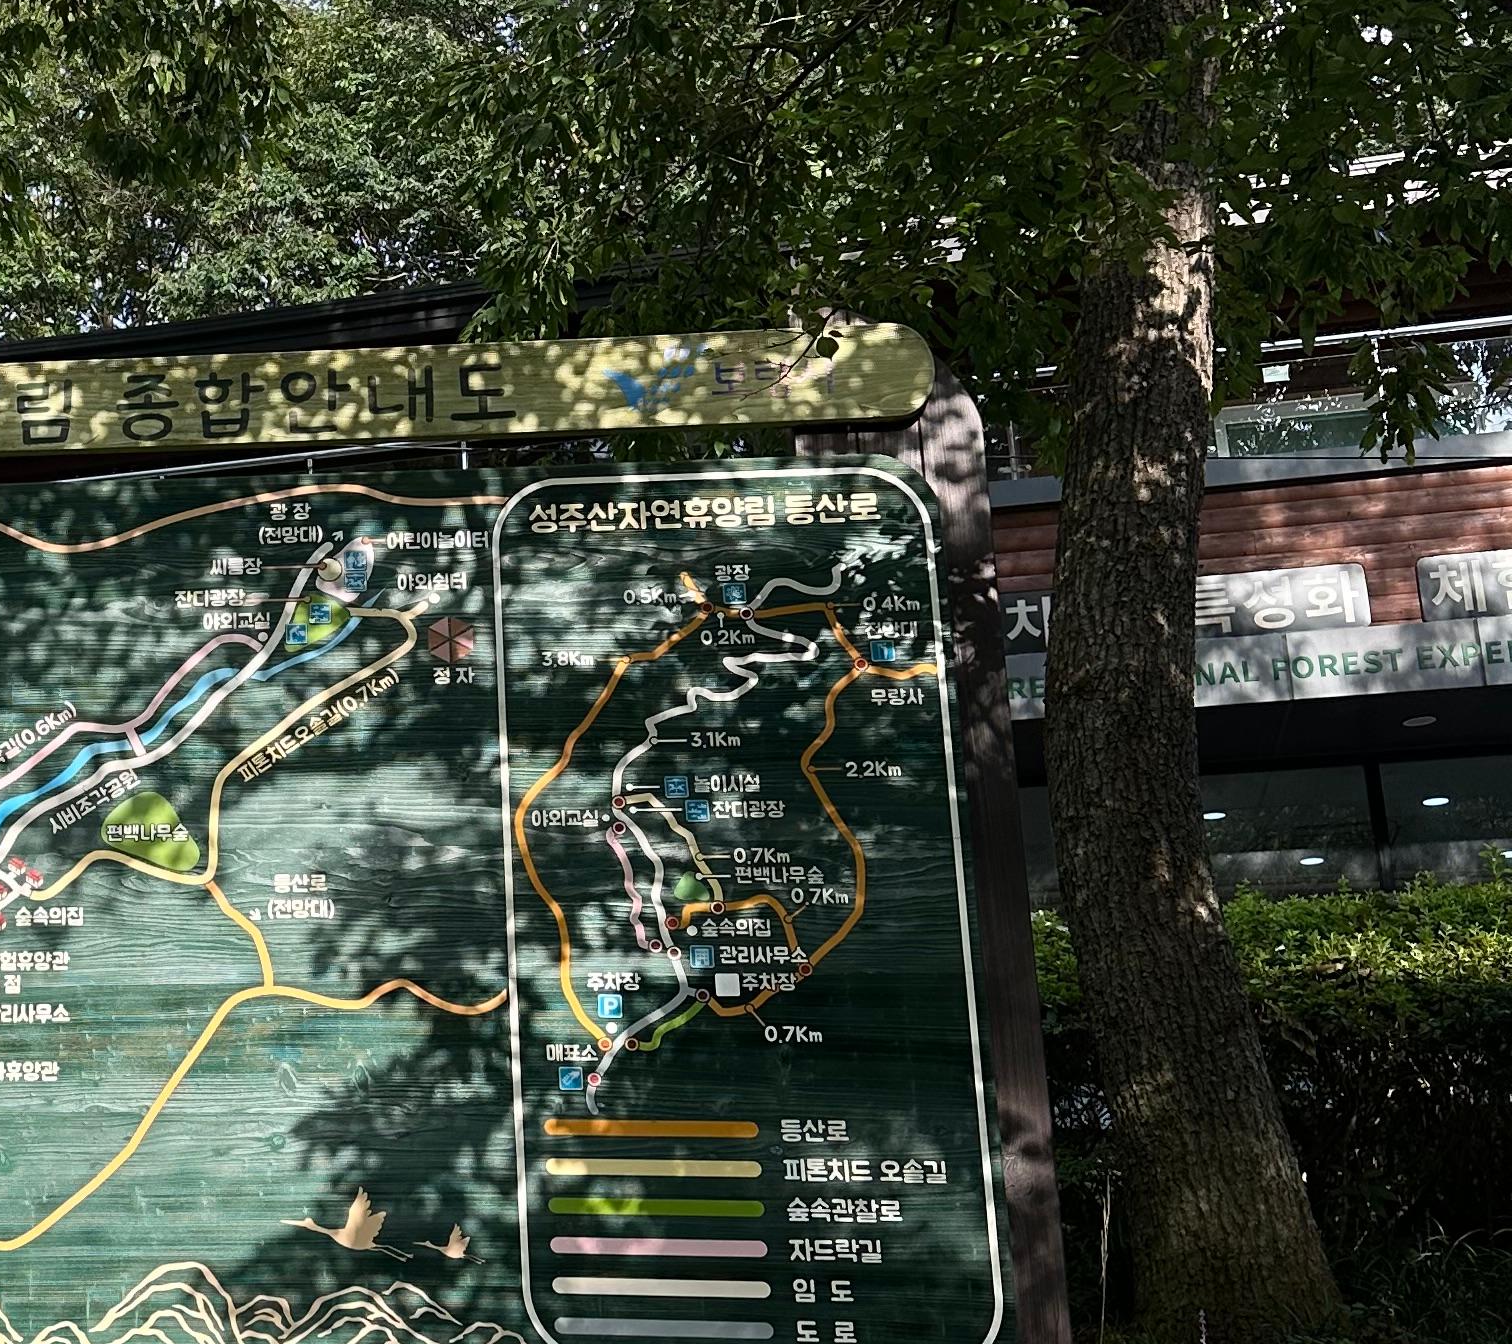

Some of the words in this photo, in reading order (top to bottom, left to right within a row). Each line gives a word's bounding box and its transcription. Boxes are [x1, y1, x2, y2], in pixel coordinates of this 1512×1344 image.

[116, 363, 518, 442] 종합안내도
[529, 497, 775, 533] 성주산자연휴양림
[785, 492, 881, 525] 등산로
[387, 530, 488, 550] 어린이놀이터
[715, 564, 750, 582] 광장
[174, 589, 246, 609] 잔디광장
[700, 629, 756, 646] 0.2Km
[1272, 648, 1403, 681] FOREST
[1416, 639, 1512, 670] EXPE
[690, 732, 741, 748] 3.1Km
[845, 761, 901, 778] 2.2Km
[693, 774, 760, 793] 놀이시설
[531, 809, 600, 828] 야외교실
[712, 800, 785, 820] 잔디광장
[733, 848, 790, 864] 0.7Km
[735, 864, 825, 885] 편백나무숲
[790, 888, 849, 905] 0.7Km
[719, 945, 809, 965] 관리사무소
[587, 972, 641, 992] 주차장
[742, 972, 797, 992] 주차장
[764, 1026, 822, 1044] 0.7Km
[780, 1119, 849, 1143] 등산로
[784, 1159, 873, 1183] 피톤치드
[880, 1159, 947, 1184] 오솔길
[787, 1199, 903, 1222] 숲속관찰로
[789, 1238, 882, 1264] 자드락길
